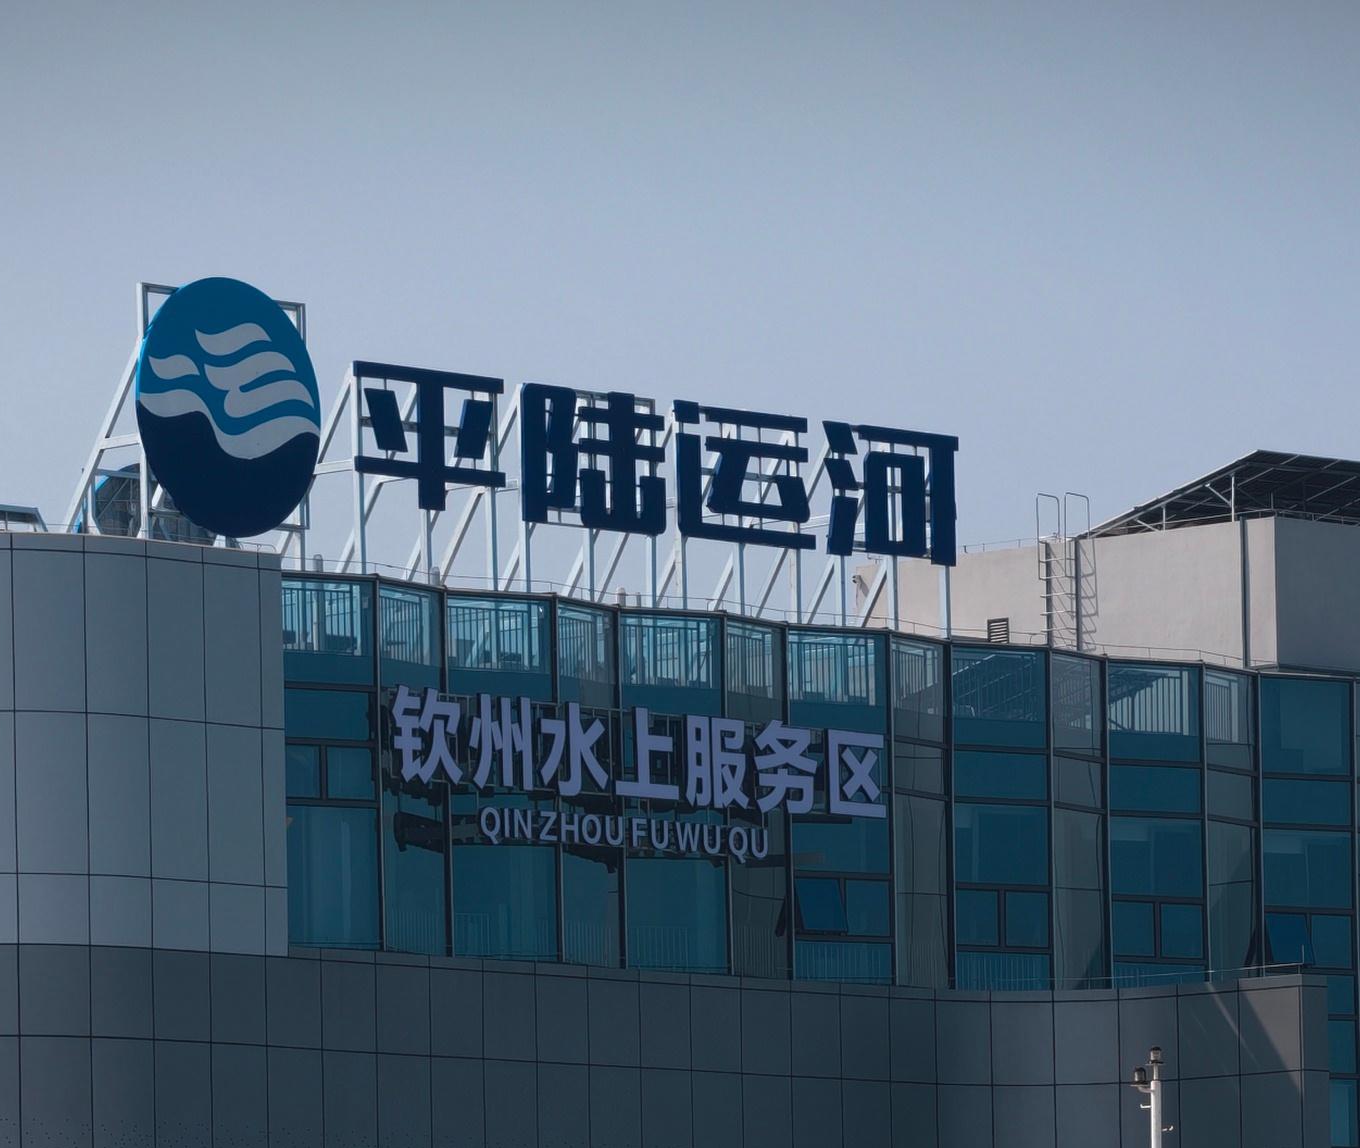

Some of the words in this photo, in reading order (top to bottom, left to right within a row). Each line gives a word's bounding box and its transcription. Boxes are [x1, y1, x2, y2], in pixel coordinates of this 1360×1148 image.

[353, 360, 959, 566] 平陆运河
[391, 684, 888, 819] 钦州水上服务区
[480, 806, 532, 845] QIN
[539, 811, 624, 846] ZHOU
[632, 817, 669, 850] FU
[675, 822, 721, 854] WU
[728, 826, 769, 864] QU
